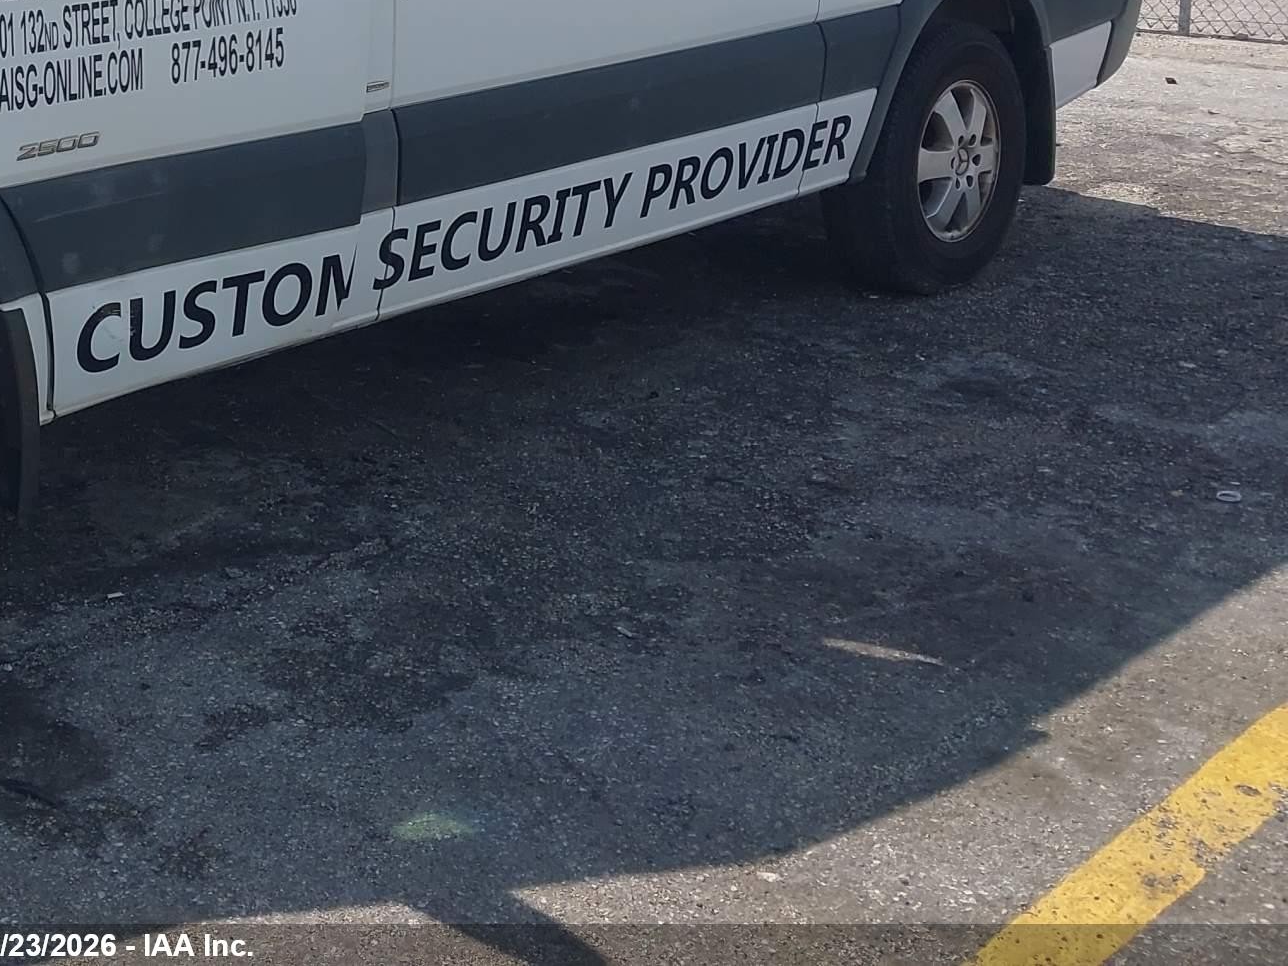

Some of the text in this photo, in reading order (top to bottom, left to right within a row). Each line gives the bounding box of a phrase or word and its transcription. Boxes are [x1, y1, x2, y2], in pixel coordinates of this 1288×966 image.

[171, 27, 285, 85] 877-496-8145
[16, 131, 100, 162] 2500
[372, 172, 632, 291] SECURITY
[639, 115, 852, 219] PROVIDER
